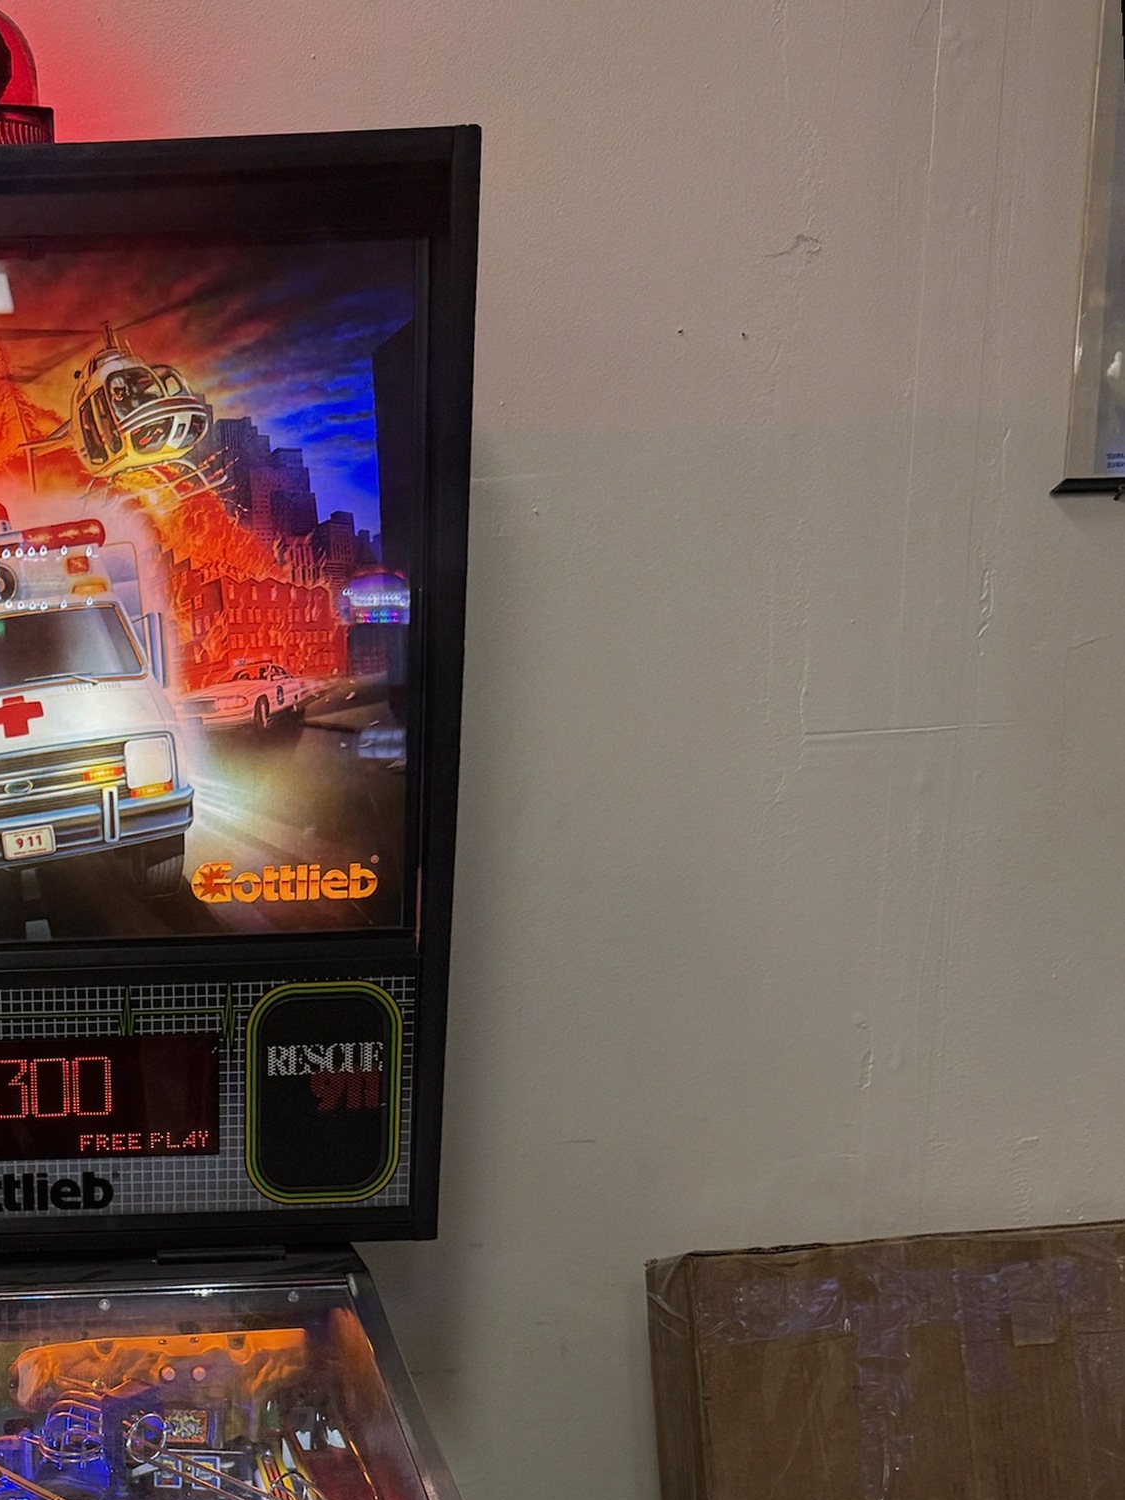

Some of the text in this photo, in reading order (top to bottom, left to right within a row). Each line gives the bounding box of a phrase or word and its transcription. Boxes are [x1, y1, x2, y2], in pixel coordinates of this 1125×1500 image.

[15, 834, 42, 848] 911
[190, 860, 379, 904] Gottlieb
[80, 1133, 142, 1152] FREE
[150, 1130, 210, 1149] PLAY
